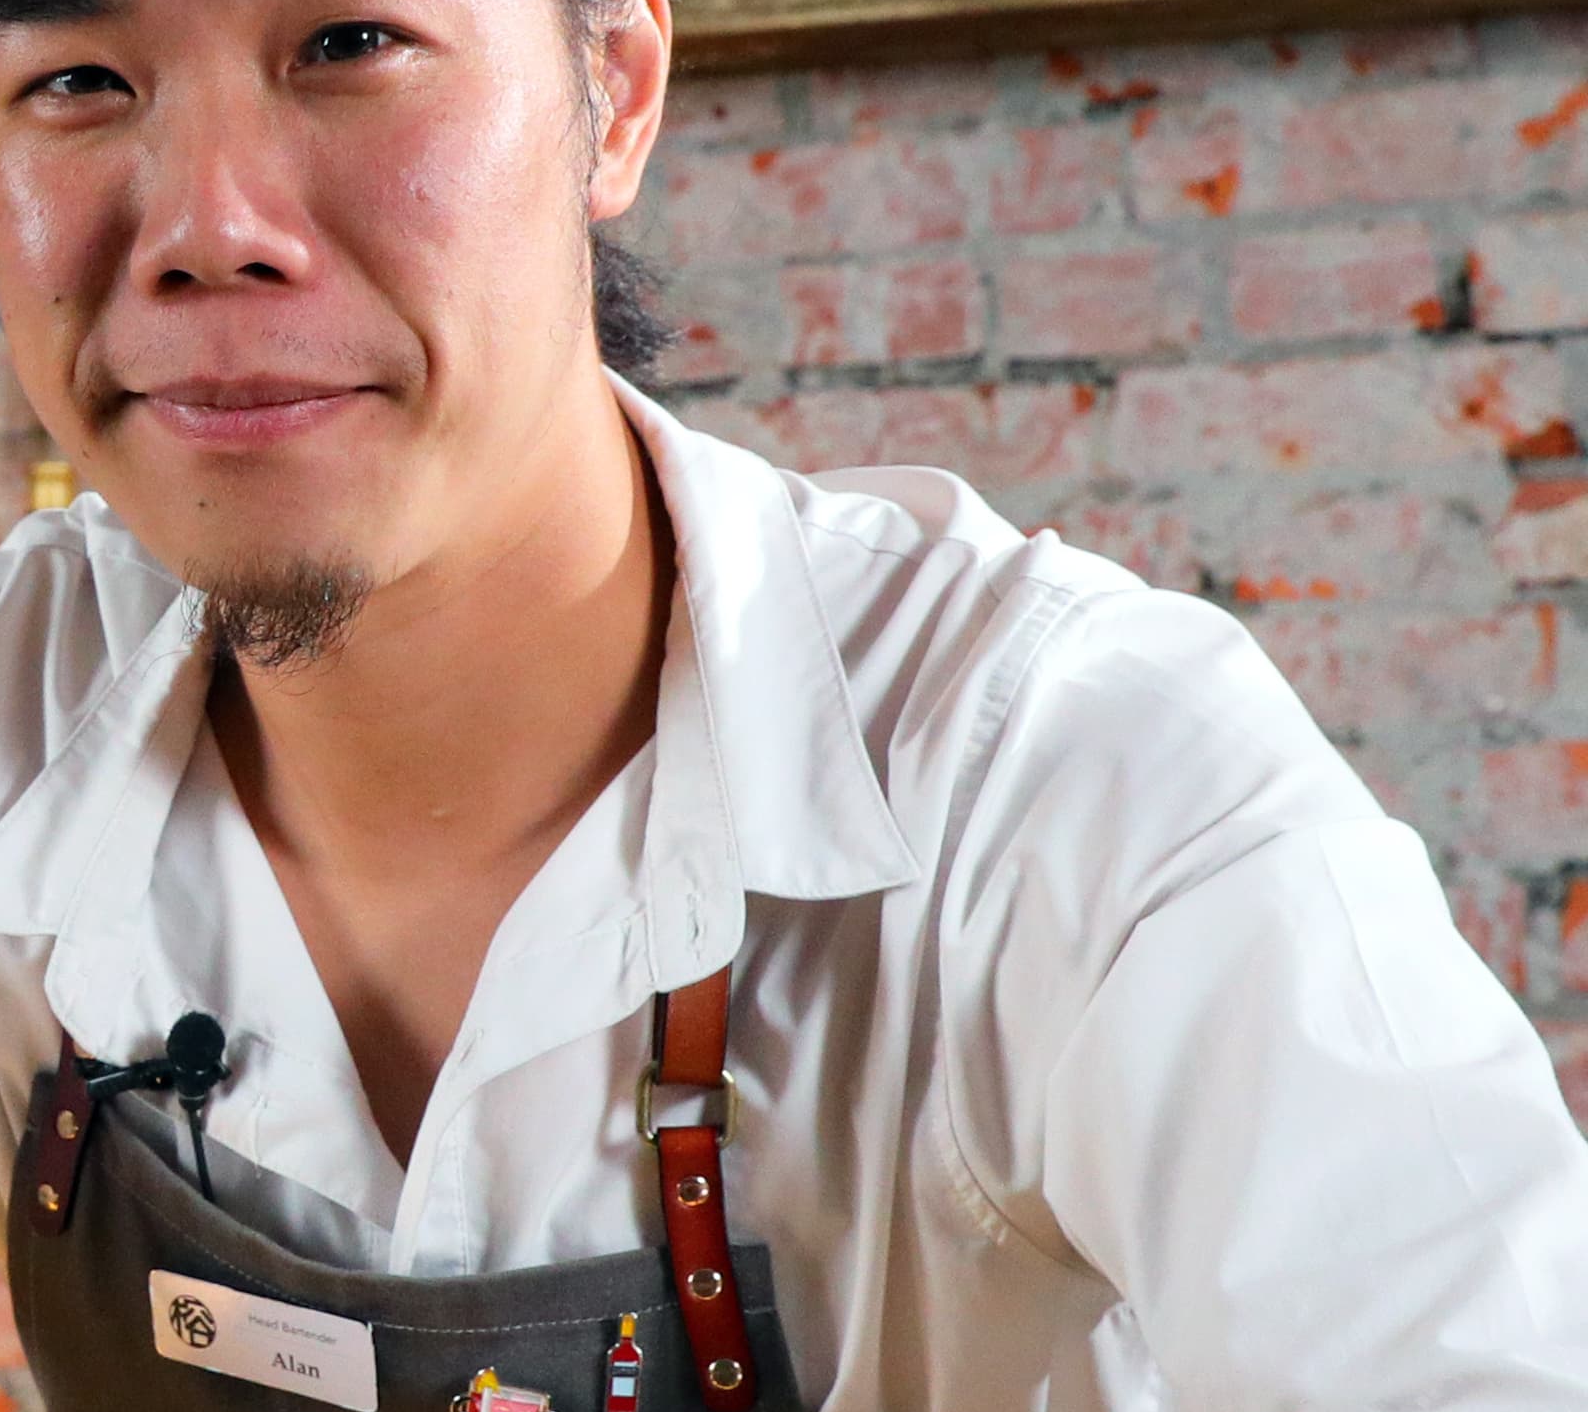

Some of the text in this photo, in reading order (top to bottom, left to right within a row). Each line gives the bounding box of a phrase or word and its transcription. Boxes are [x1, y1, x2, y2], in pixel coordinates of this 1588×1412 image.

[247, 1314, 338, 1345] Head Bartender
[271, 1352, 321, 1379] Alan
